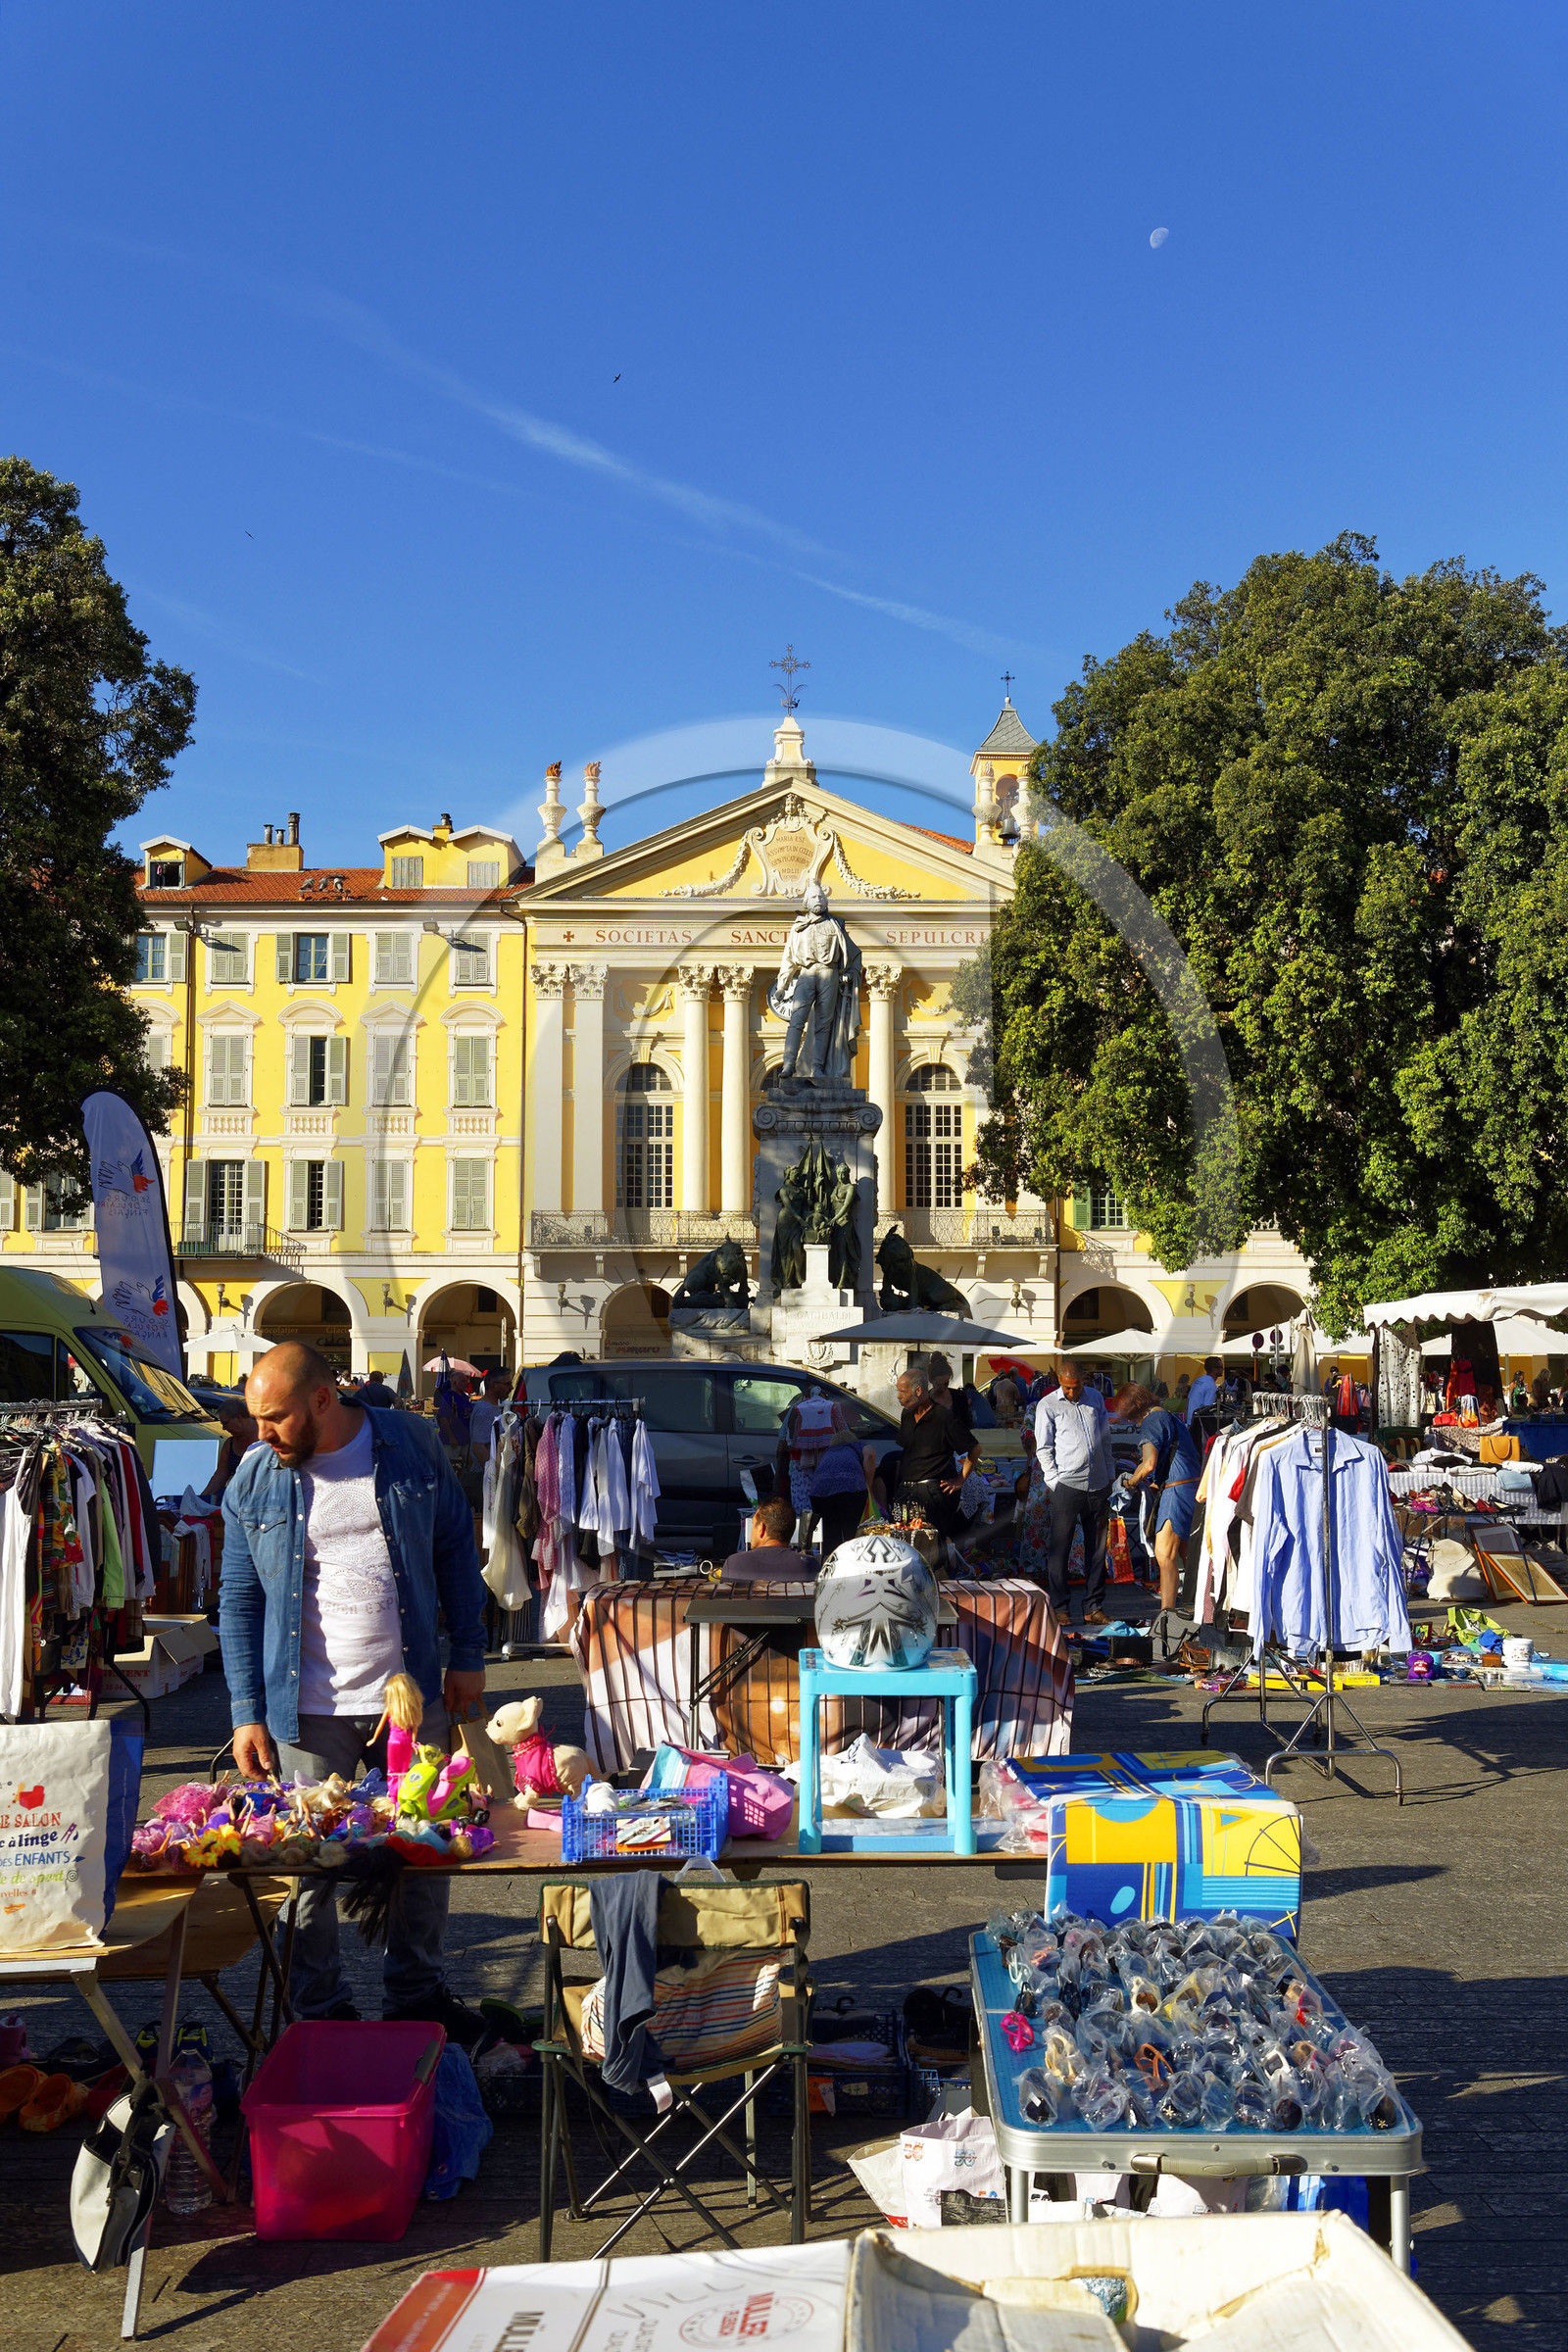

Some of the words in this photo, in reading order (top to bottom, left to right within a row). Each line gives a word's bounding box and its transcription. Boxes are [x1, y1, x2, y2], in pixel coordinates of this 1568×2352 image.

[595, 929, 693, 944] SOCIETAS
[730, 930, 793, 944] SANCT
[886, 930, 986, 944] SEPULCRI
[15, 1811, 62, 1829] SALON
[8, 1837, 17, 1848] à
[18, 1831, 59, 1848] linge
[15, 1850, 71, 1867] ENFANTS
[11, 1871, 26, 1885] de
[29, 1869, 65, 1887] sport
